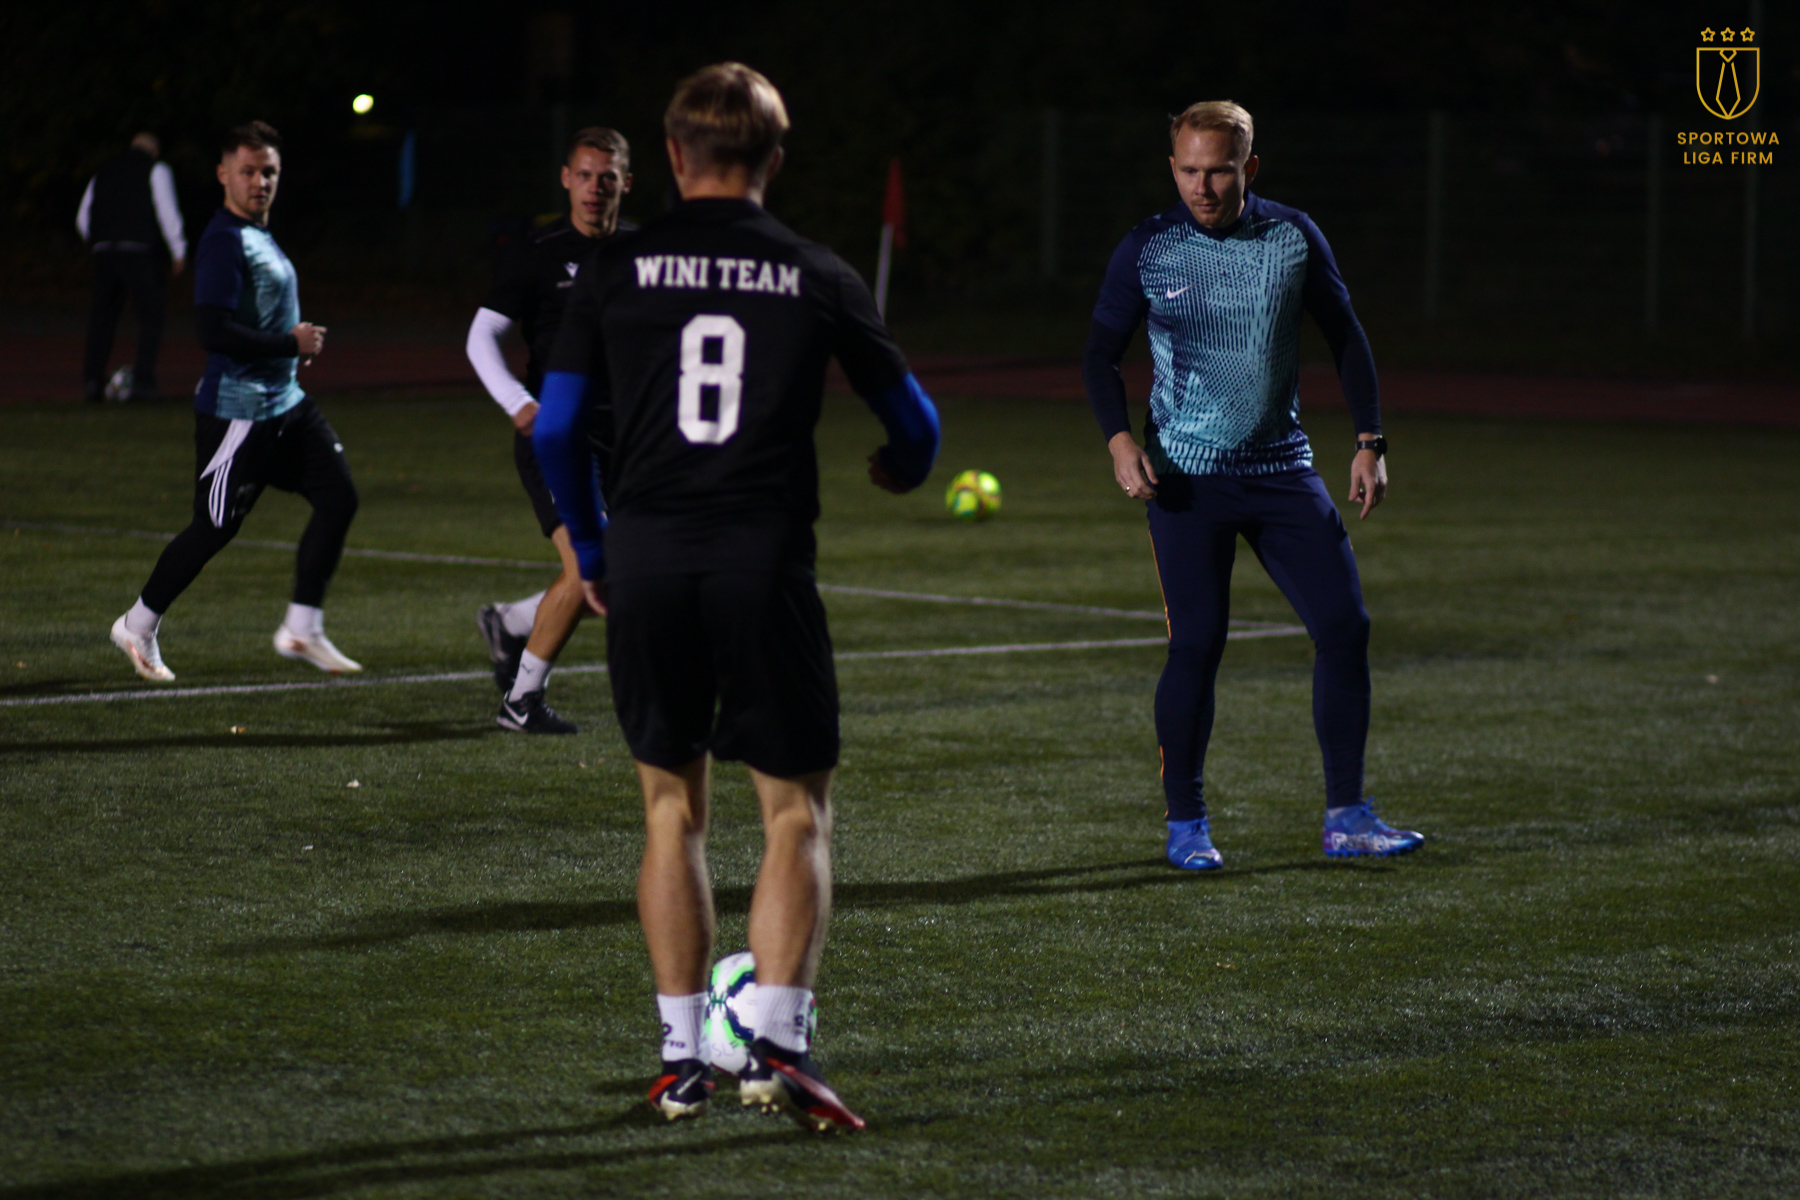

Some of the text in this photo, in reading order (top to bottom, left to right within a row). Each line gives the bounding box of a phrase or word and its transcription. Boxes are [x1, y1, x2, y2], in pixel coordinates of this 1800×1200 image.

[634, 254, 802, 298] WINI TEAM
[677, 313, 747, 446] 8
